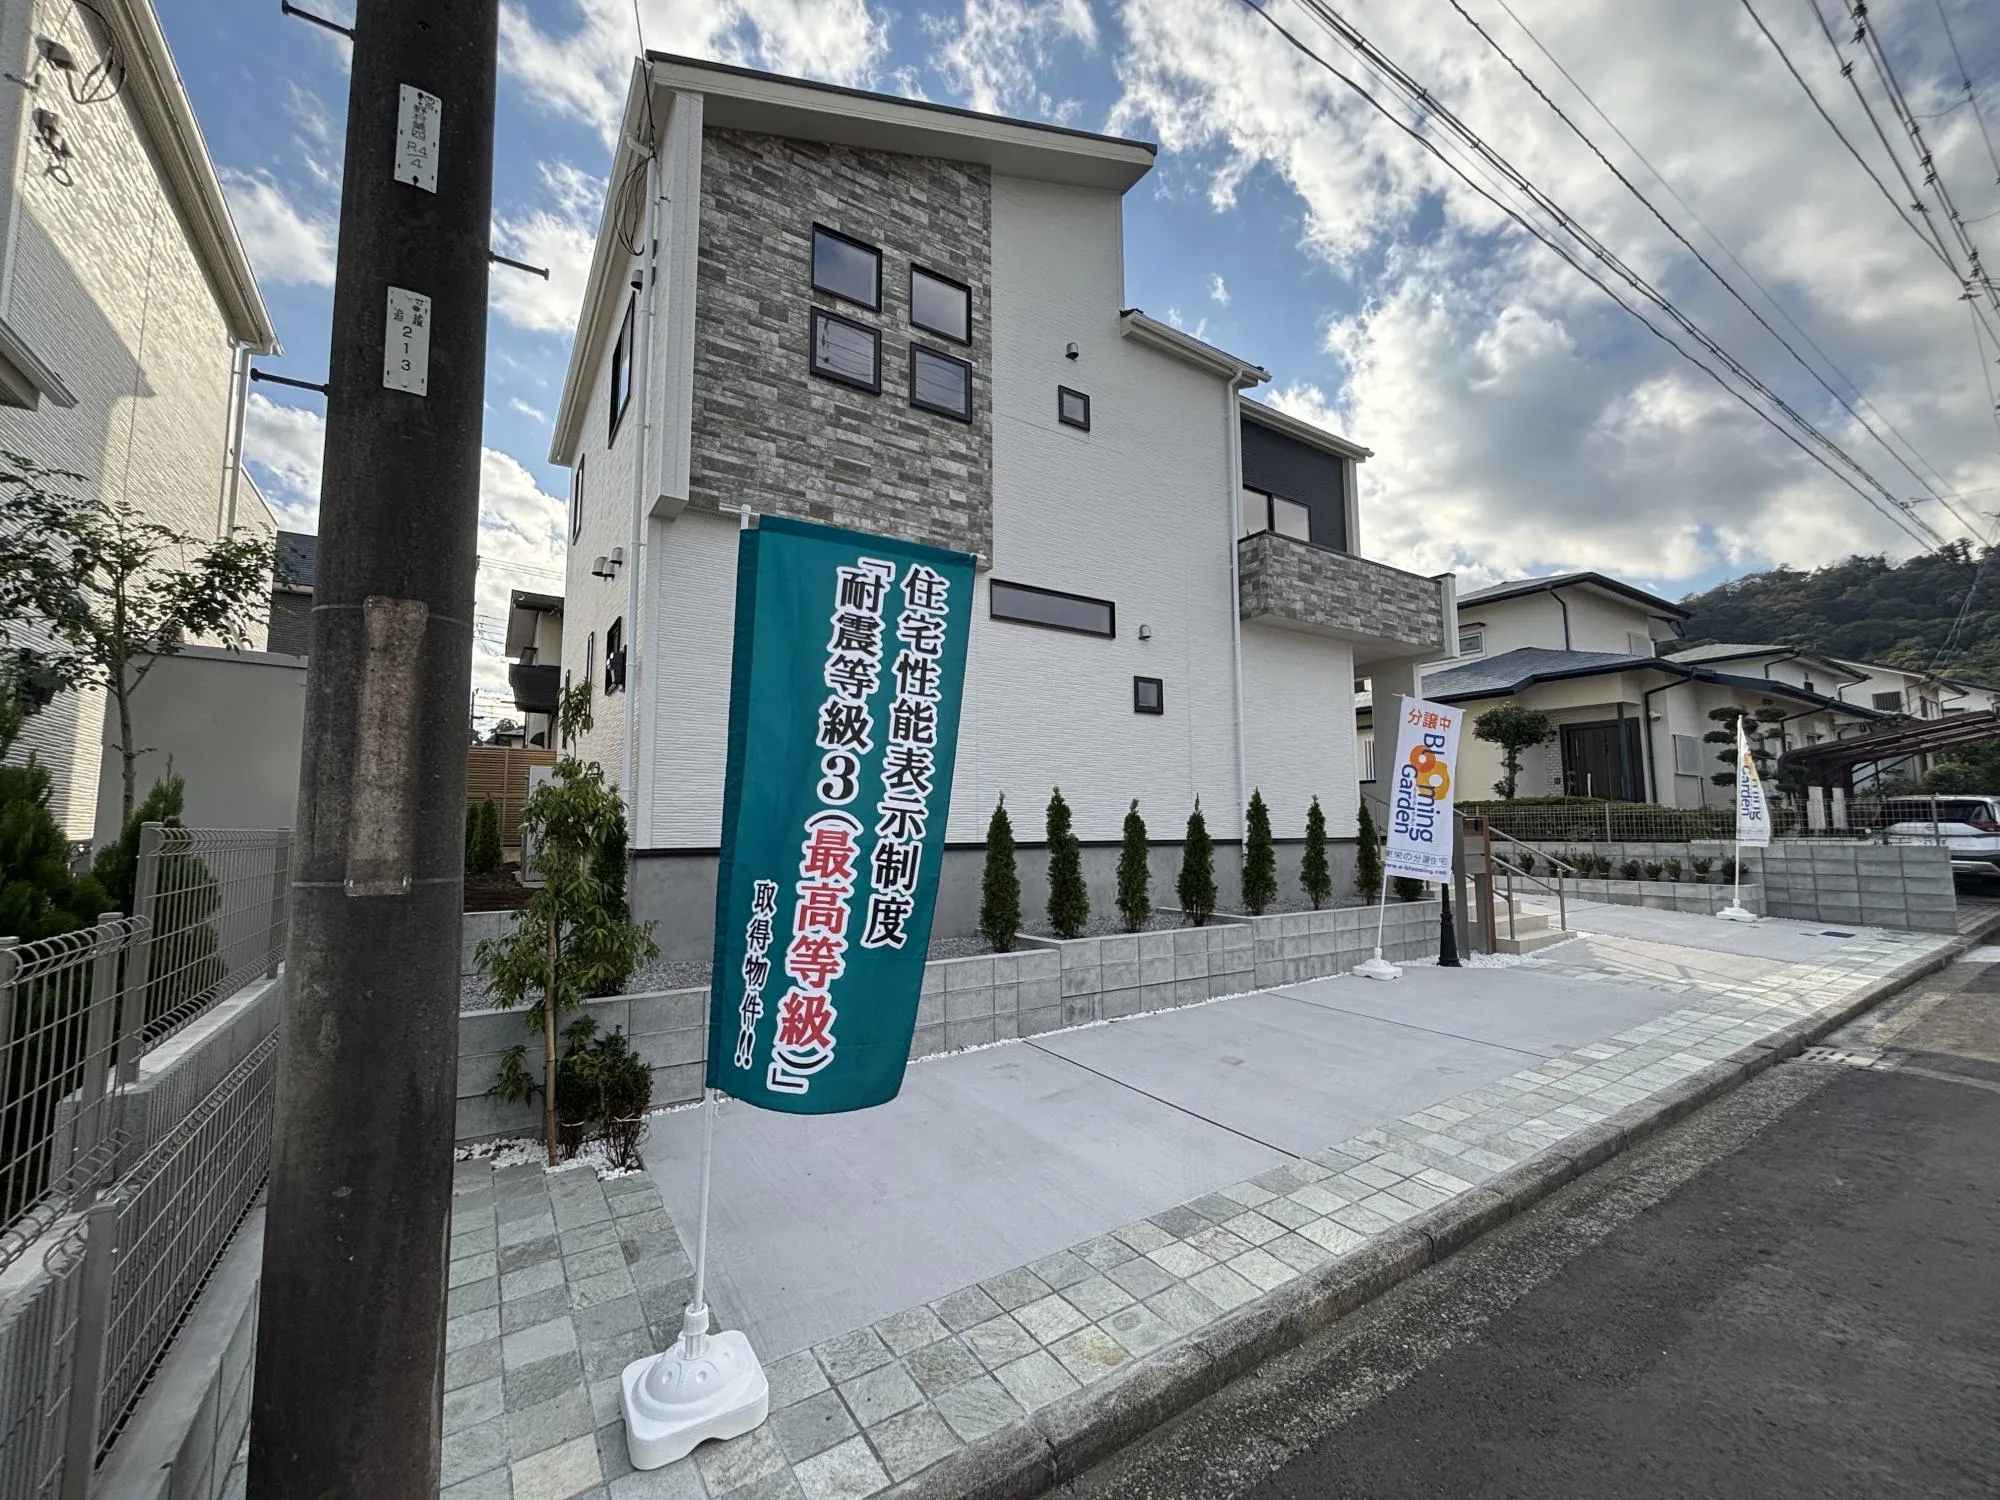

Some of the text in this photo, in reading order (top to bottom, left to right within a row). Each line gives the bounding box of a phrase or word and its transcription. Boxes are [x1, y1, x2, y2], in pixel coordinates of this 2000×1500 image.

[1407, 708, 1452, 732] 分譲中
[863, 567, 949, 946] 住宅性能表示制度
[1394, 764, 1418, 834] Garden
[1740, 765, 1753, 816] Garden
